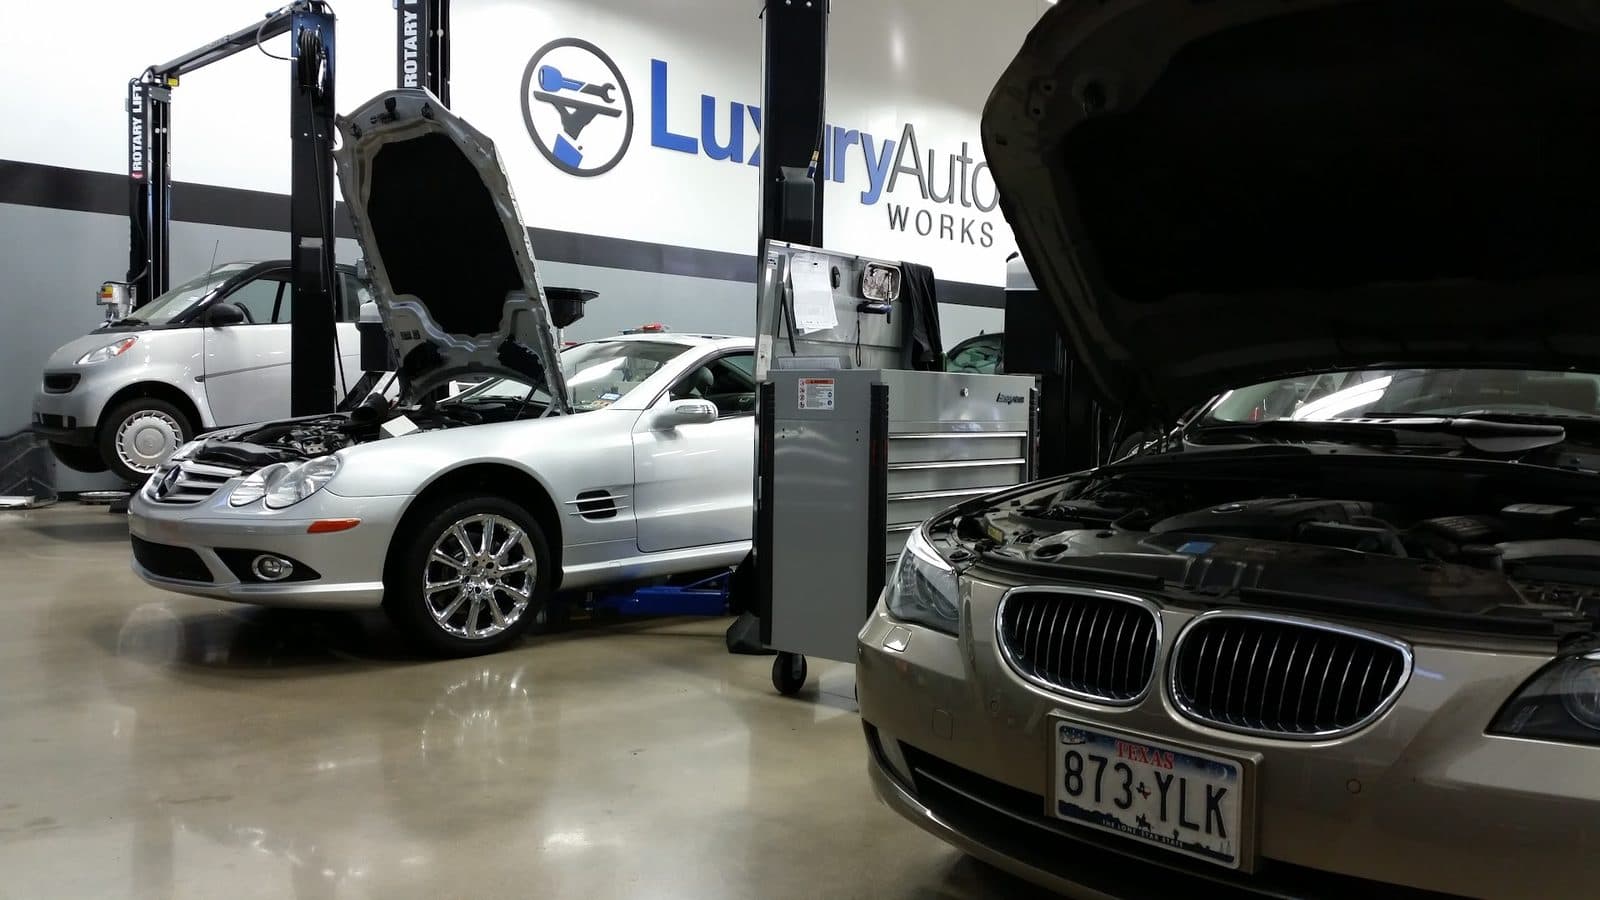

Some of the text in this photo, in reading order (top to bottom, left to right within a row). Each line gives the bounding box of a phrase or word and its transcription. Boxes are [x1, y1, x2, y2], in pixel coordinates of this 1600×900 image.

[403, 9, 418, 88] ROTARY
[132, 84, 143, 171] ROTARY LIFT
[887, 202, 994, 248] WORKS
[1064, 750, 1227, 839] 873 YLK
[1117, 741, 1174, 769] TEXAS
